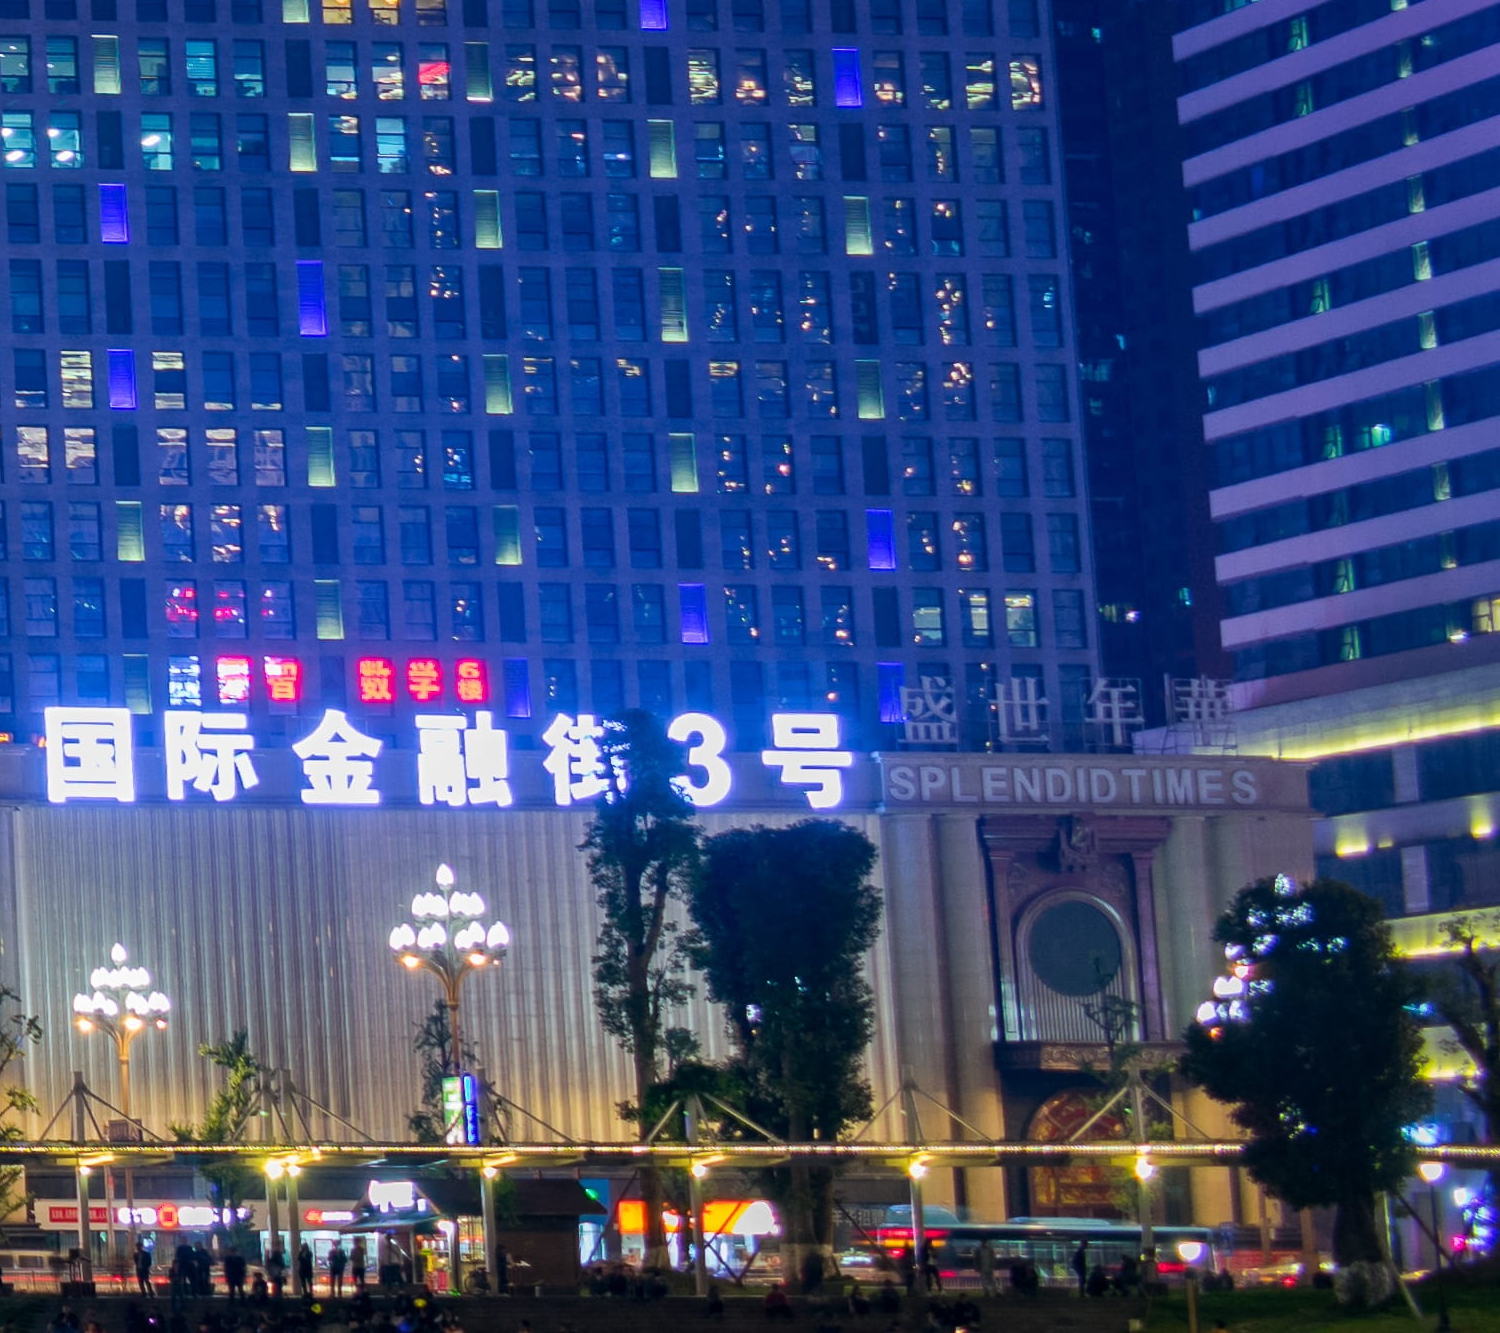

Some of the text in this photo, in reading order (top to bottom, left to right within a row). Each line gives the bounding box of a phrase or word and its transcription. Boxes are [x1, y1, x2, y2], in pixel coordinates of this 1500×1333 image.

[45, 706, 854, 808] 国际金融街3号
